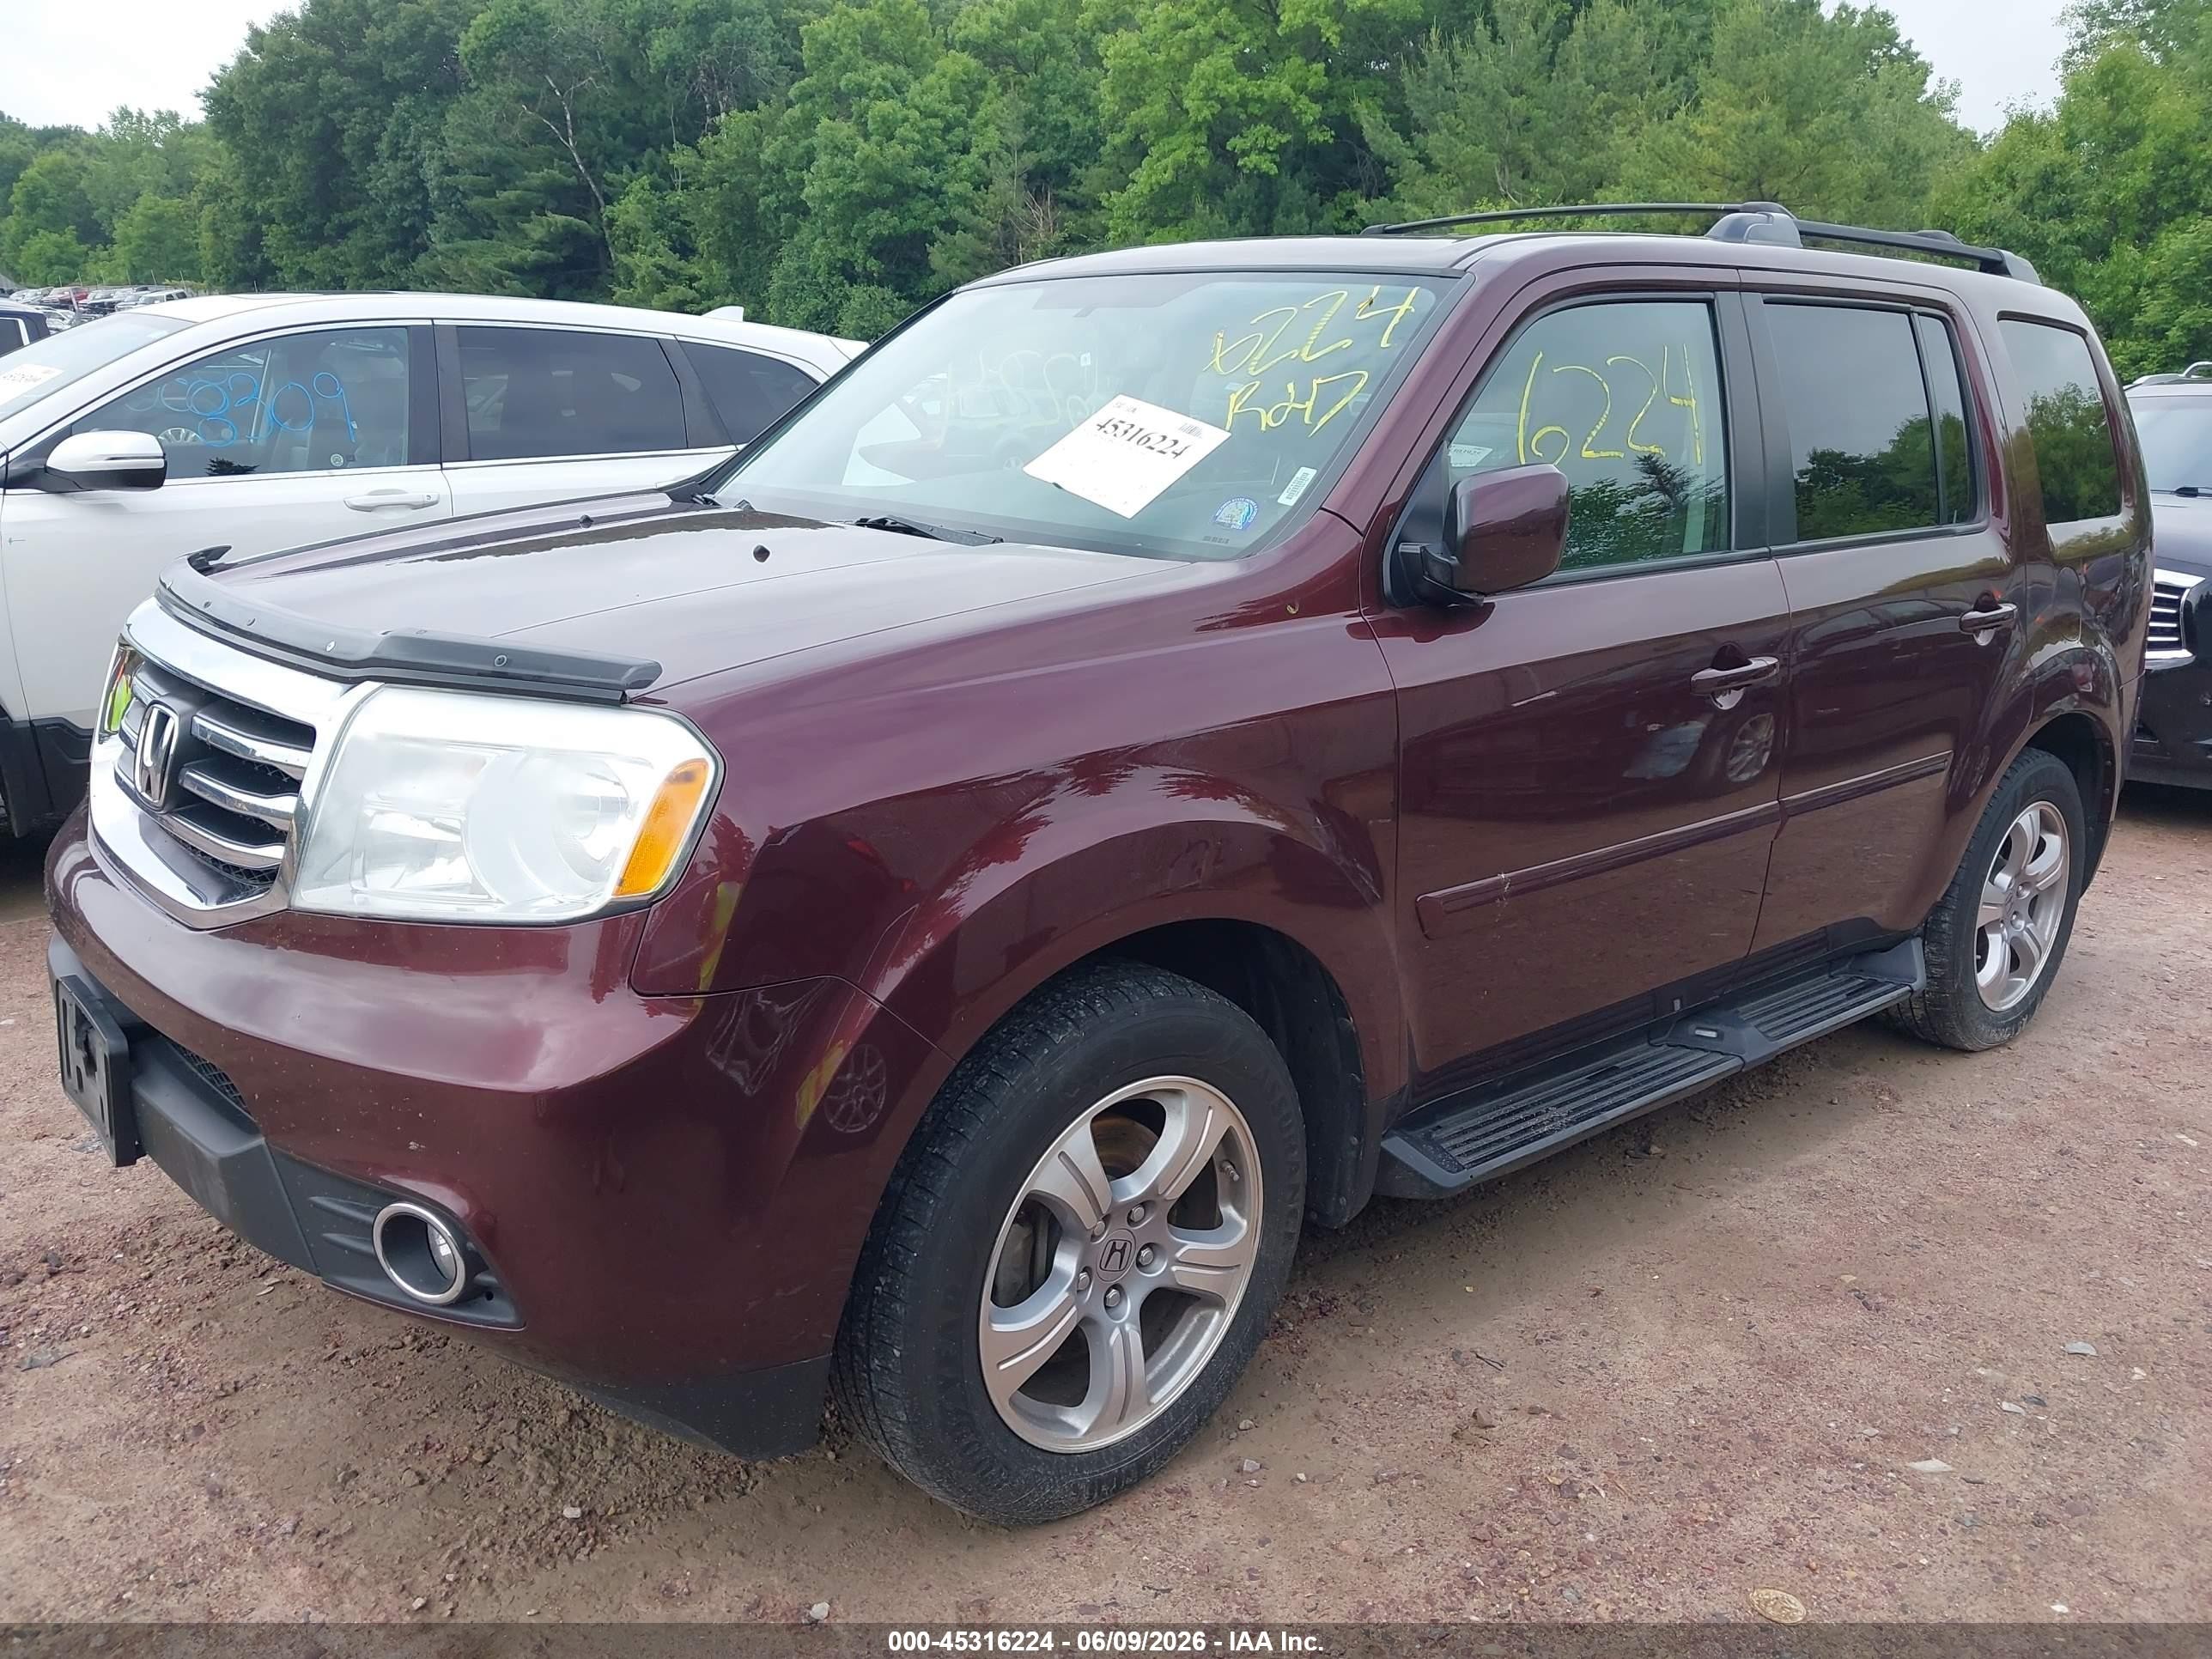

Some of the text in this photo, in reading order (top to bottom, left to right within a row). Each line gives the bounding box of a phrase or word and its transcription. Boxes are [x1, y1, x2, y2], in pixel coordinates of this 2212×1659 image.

[1202, 285, 1420, 375] 6224
[1096, 417, 1193, 459] 45316224
[1517, 343, 1703, 466] 6224
